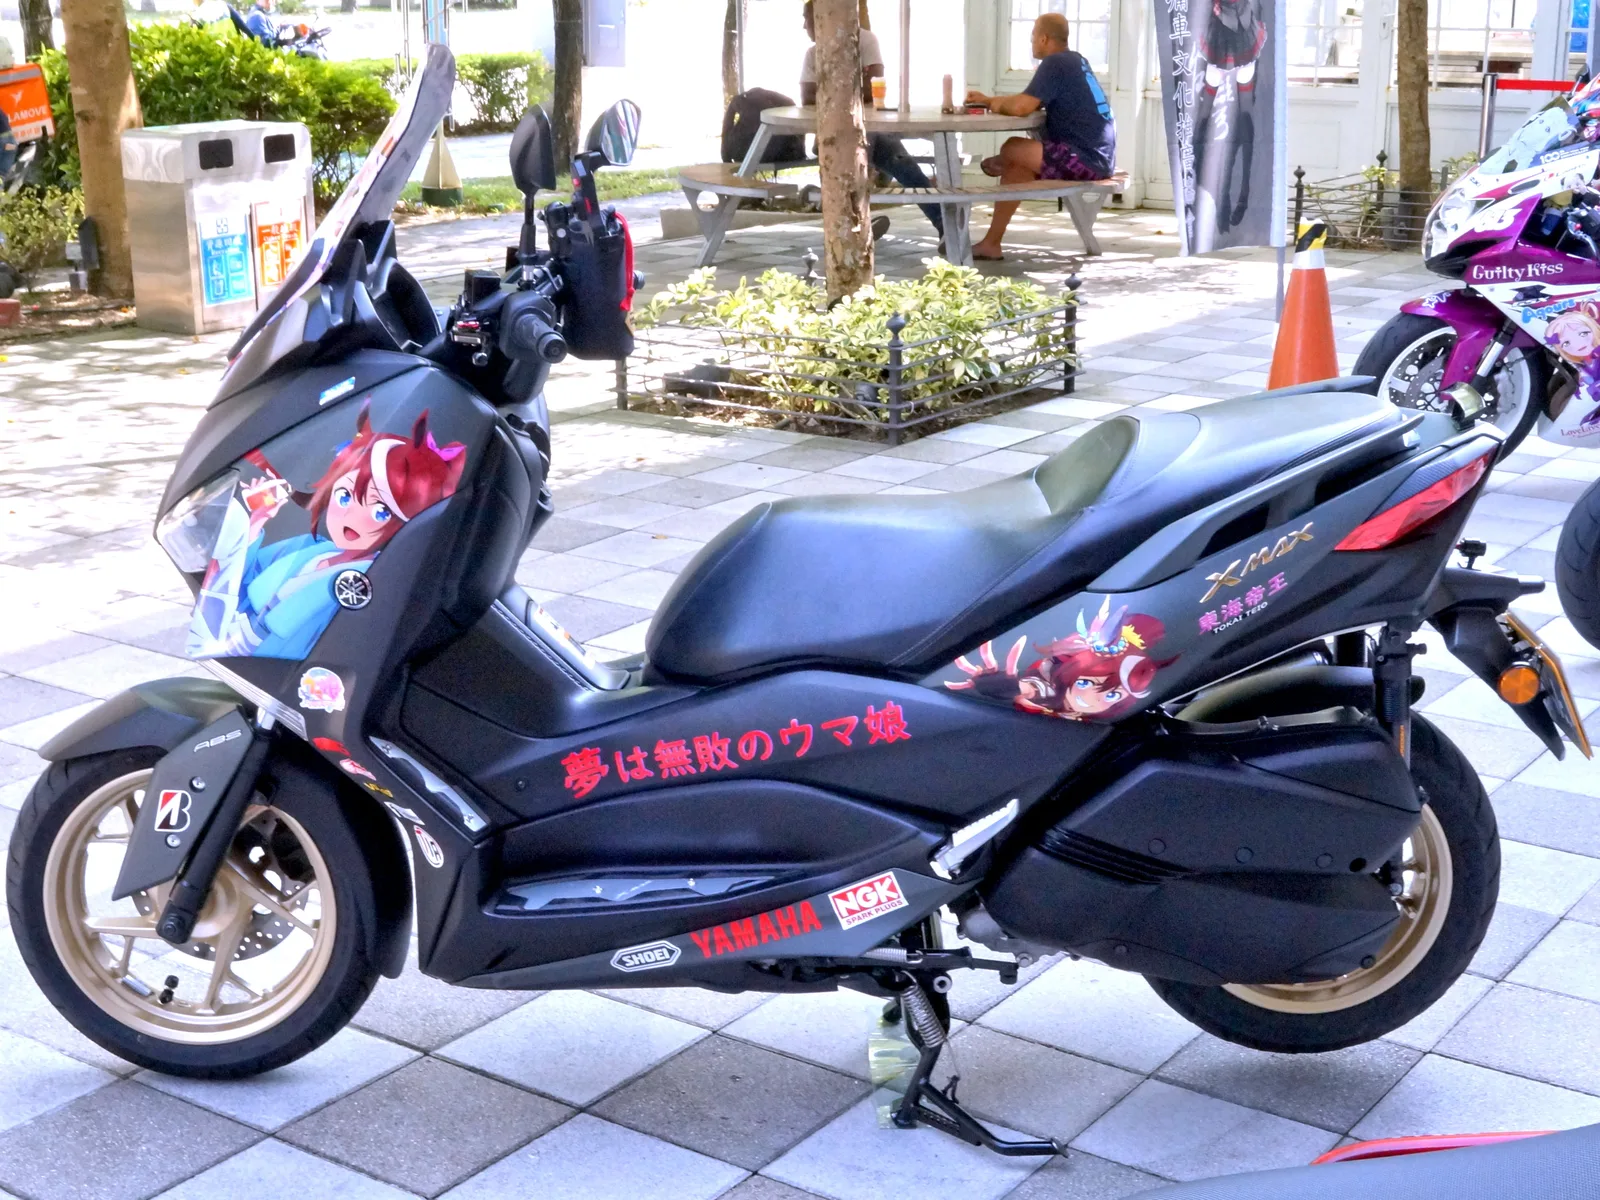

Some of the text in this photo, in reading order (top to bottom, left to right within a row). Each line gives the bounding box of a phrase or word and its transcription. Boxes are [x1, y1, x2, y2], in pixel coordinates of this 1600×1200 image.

[7, 105, 48, 123] LAMOVE
[1472, 263, 1564, 282] Guilty Kiss
[1198, 571, 1289, 636] 東海帝王
[1212, 601, 1269, 635] TOKAI TEIO
[193, 729, 242, 753] ABS
[560, 700, 913, 799] 夢は無敗のウマ娘
[832, 876, 902, 918] NGK
[845, 899, 904, 926] SPARK PLUGS
[689, 900, 823, 960] YAMAHA
[621, 948, 671, 968] SHOEI
